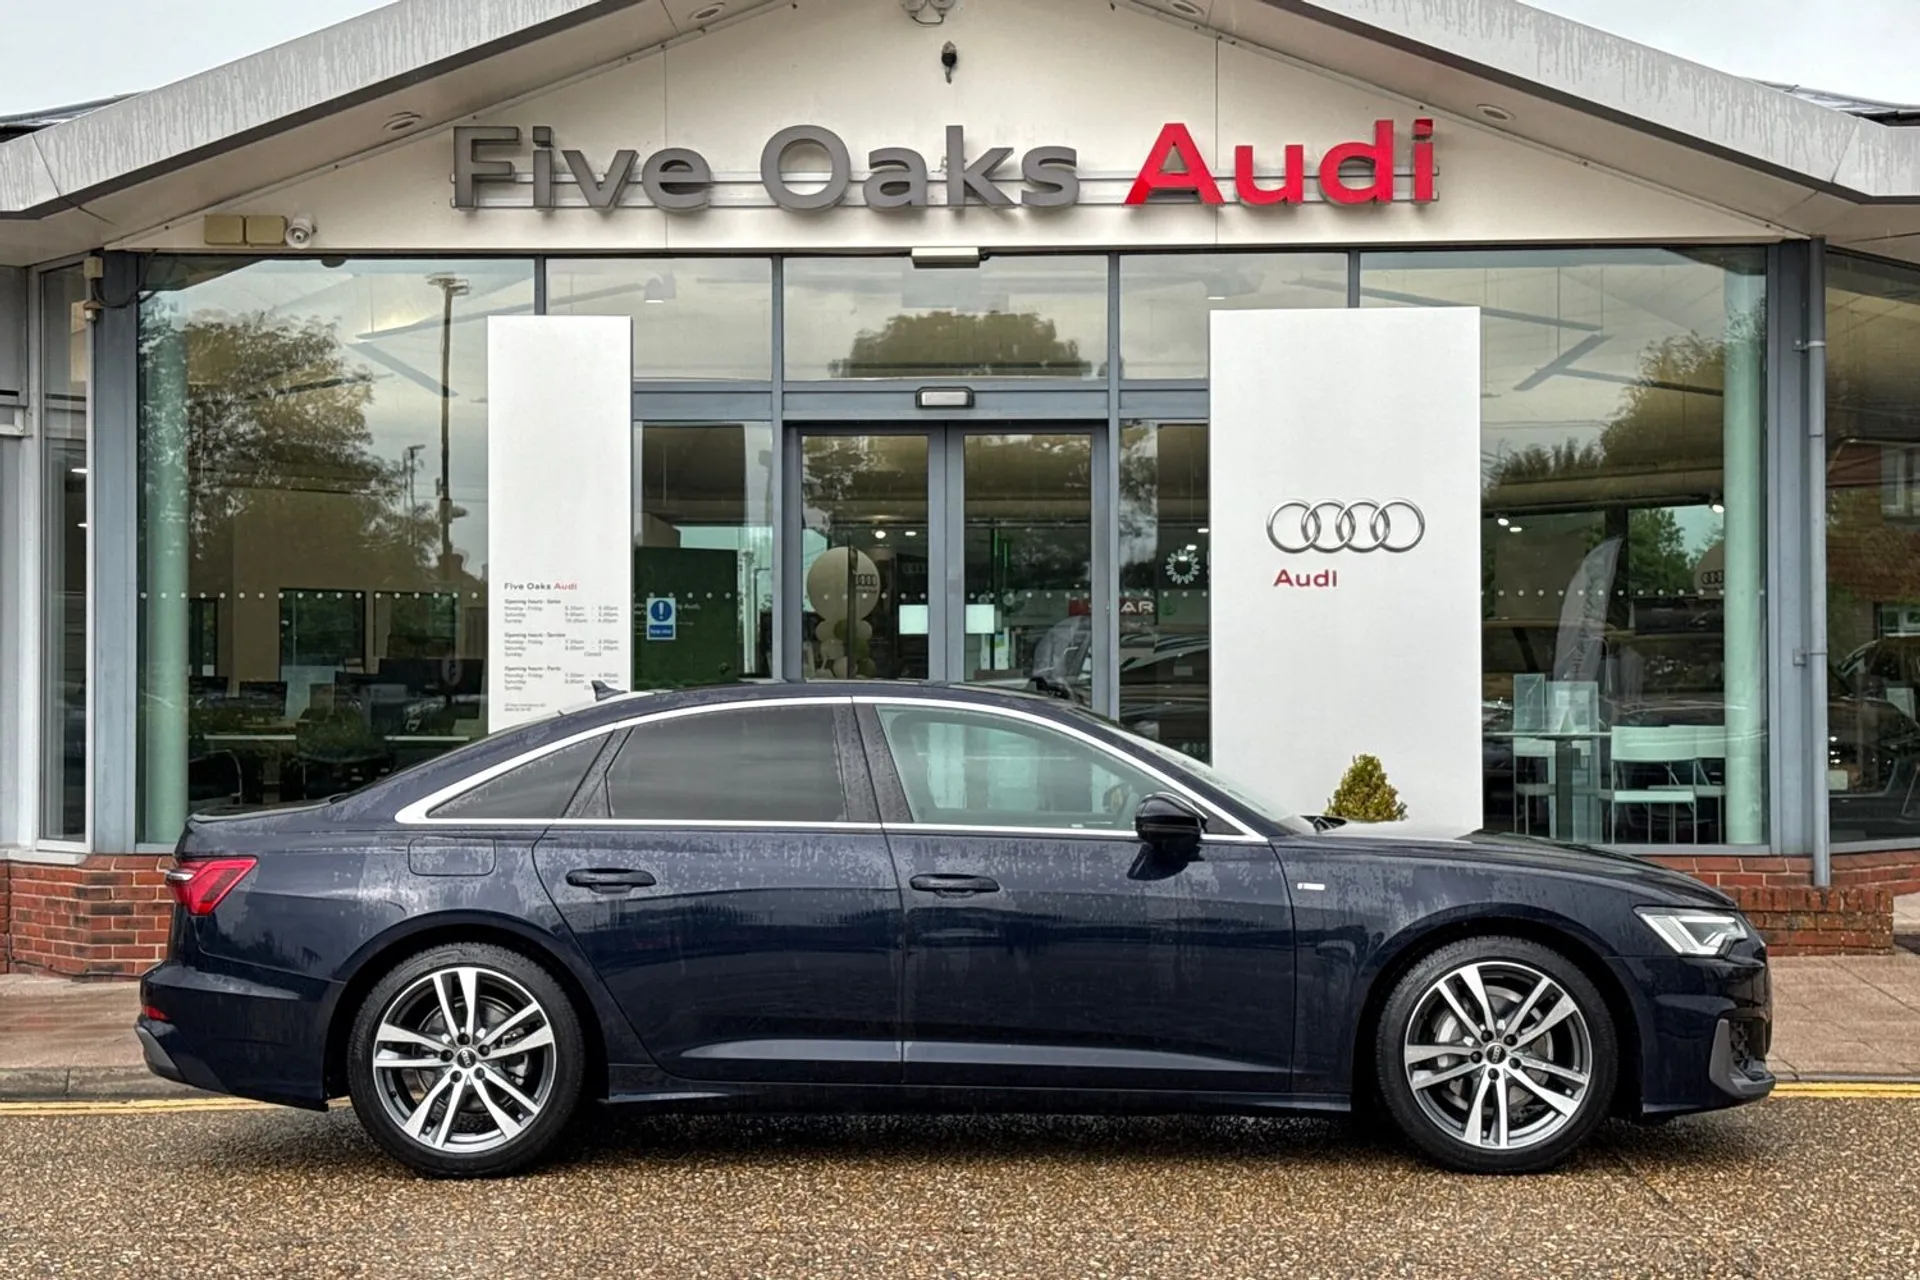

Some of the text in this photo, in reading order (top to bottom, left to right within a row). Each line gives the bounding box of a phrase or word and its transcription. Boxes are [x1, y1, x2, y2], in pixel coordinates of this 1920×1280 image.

[453, 118, 1434, 213] Five Oaks Audi
[504, 582, 577, 590] Five Oaks Audi
[1273, 568, 1338, 588] Audi
